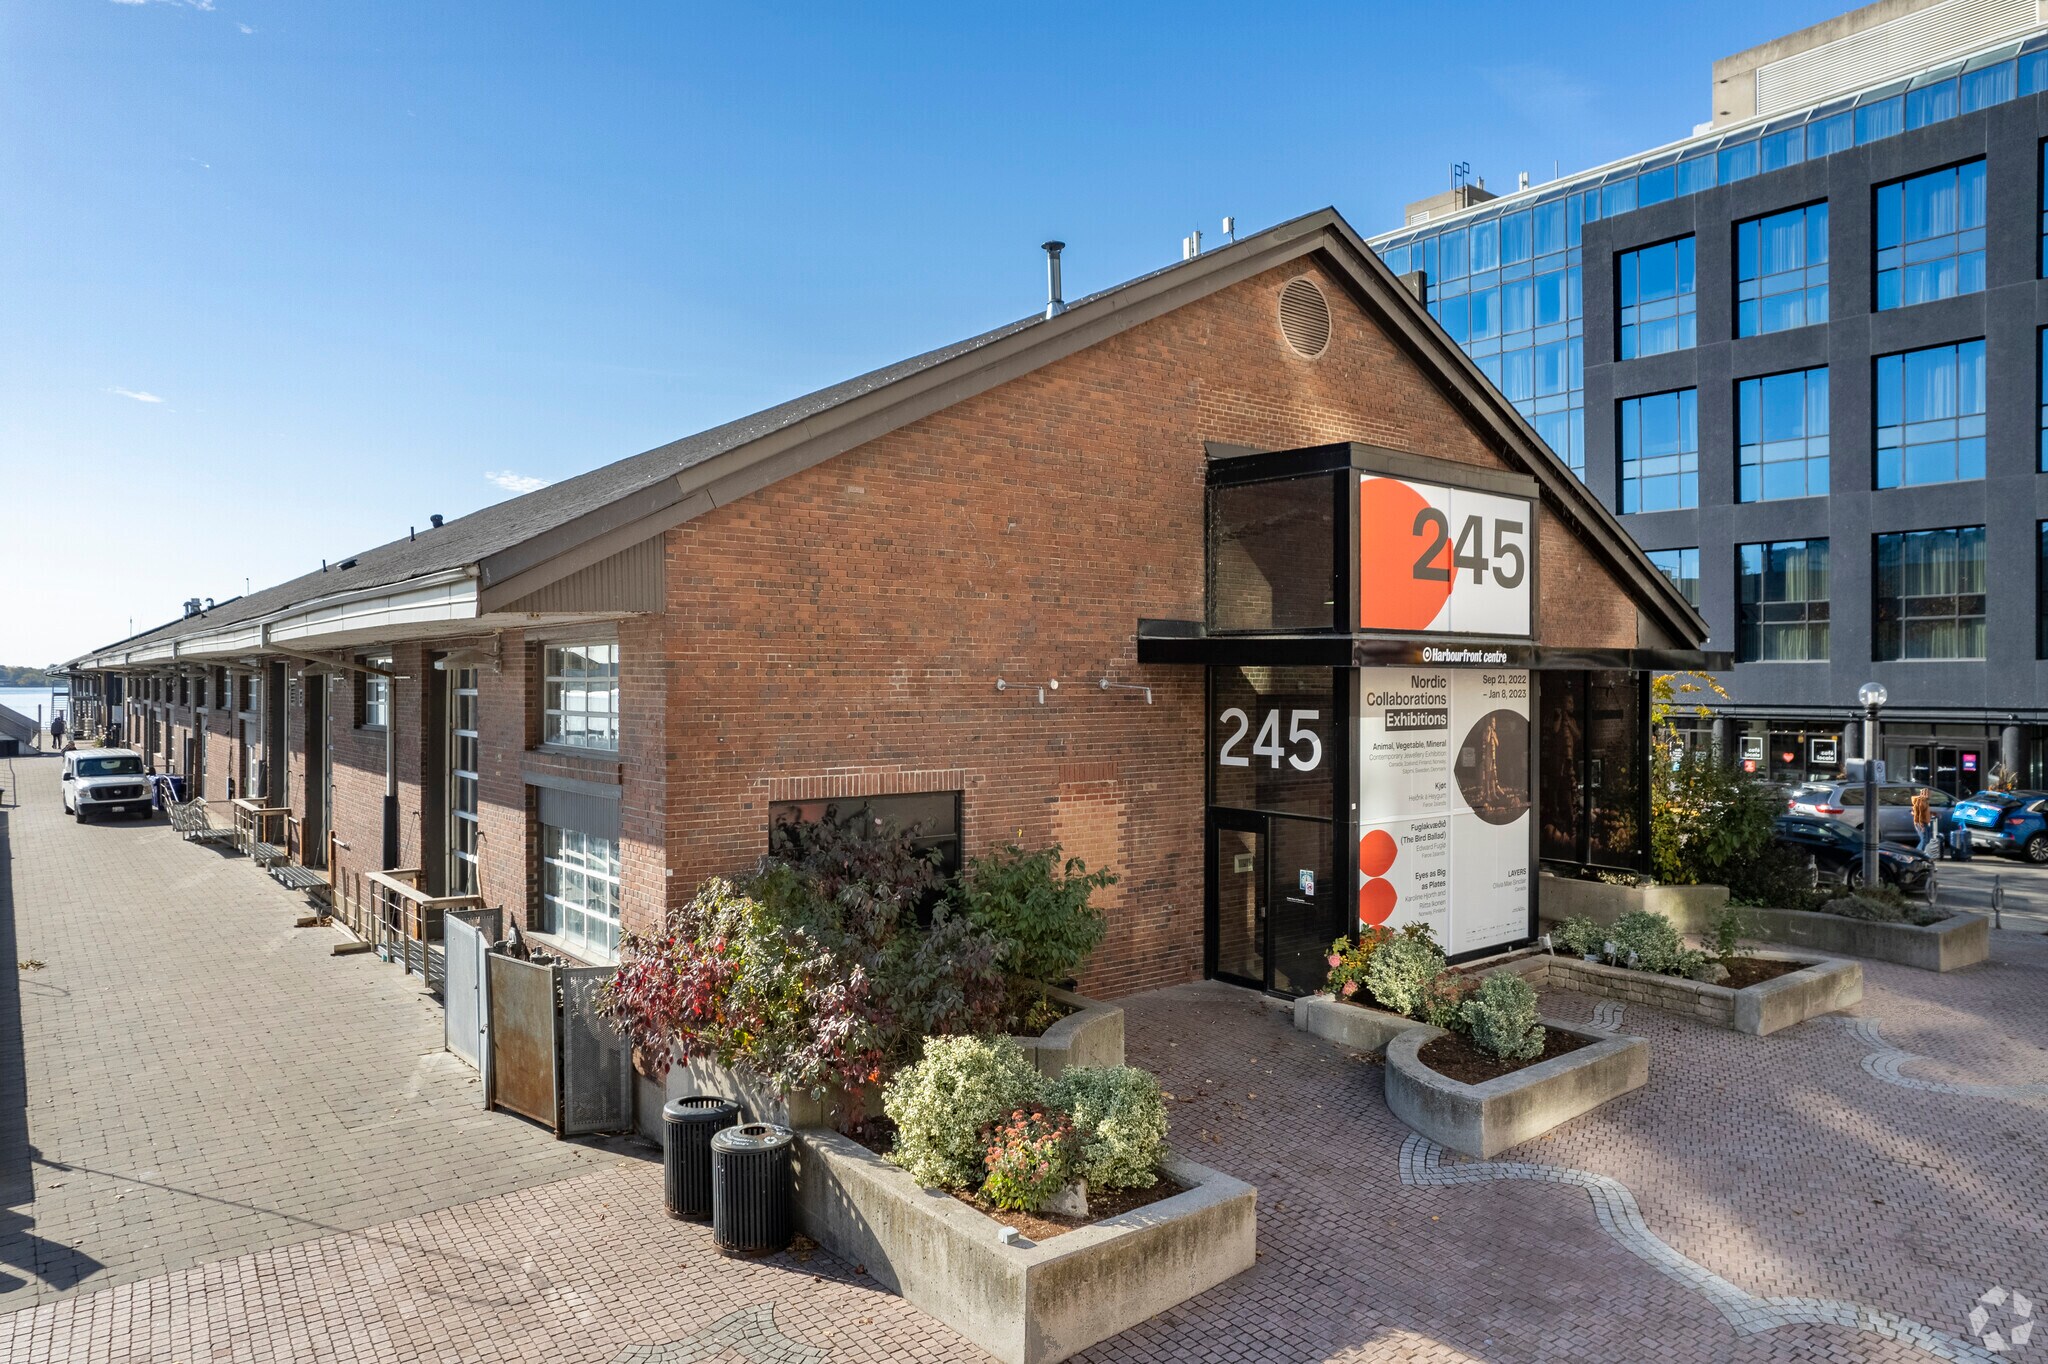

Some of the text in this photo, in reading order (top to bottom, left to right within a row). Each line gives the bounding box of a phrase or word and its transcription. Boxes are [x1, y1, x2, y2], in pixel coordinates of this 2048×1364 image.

[1412, 507, 1525, 589] 245
[1432, 648, 1507, 663] Harbourfront centre
[1411, 675, 1447, 689] Nordic
[1483, 675, 1527, 686] Sep 21, 2022
[1367, 691, 1447, 706] Collaborations
[1489, 690, 1500, 699] Jan
[1501, 690, 1507, 700] 8,
[1509, 690, 1527, 699] 2023
[1386, 711, 1447, 727] Exhibitions
[1220, 707, 1322, 772] 245
[1373, 739, 1446, 751] Animal, Vegetable, Mineral
[1369, 753, 1403, 761] Contemporary
[1401, 831, 1446, 846] (The Bird Ballad)
[1415, 872, 1428, 881] Eyes
[1437, 868, 1446, 878] Big
[1508, 868, 1526, 877] LAYERS
[1429, 881, 1446, 889] Plates
